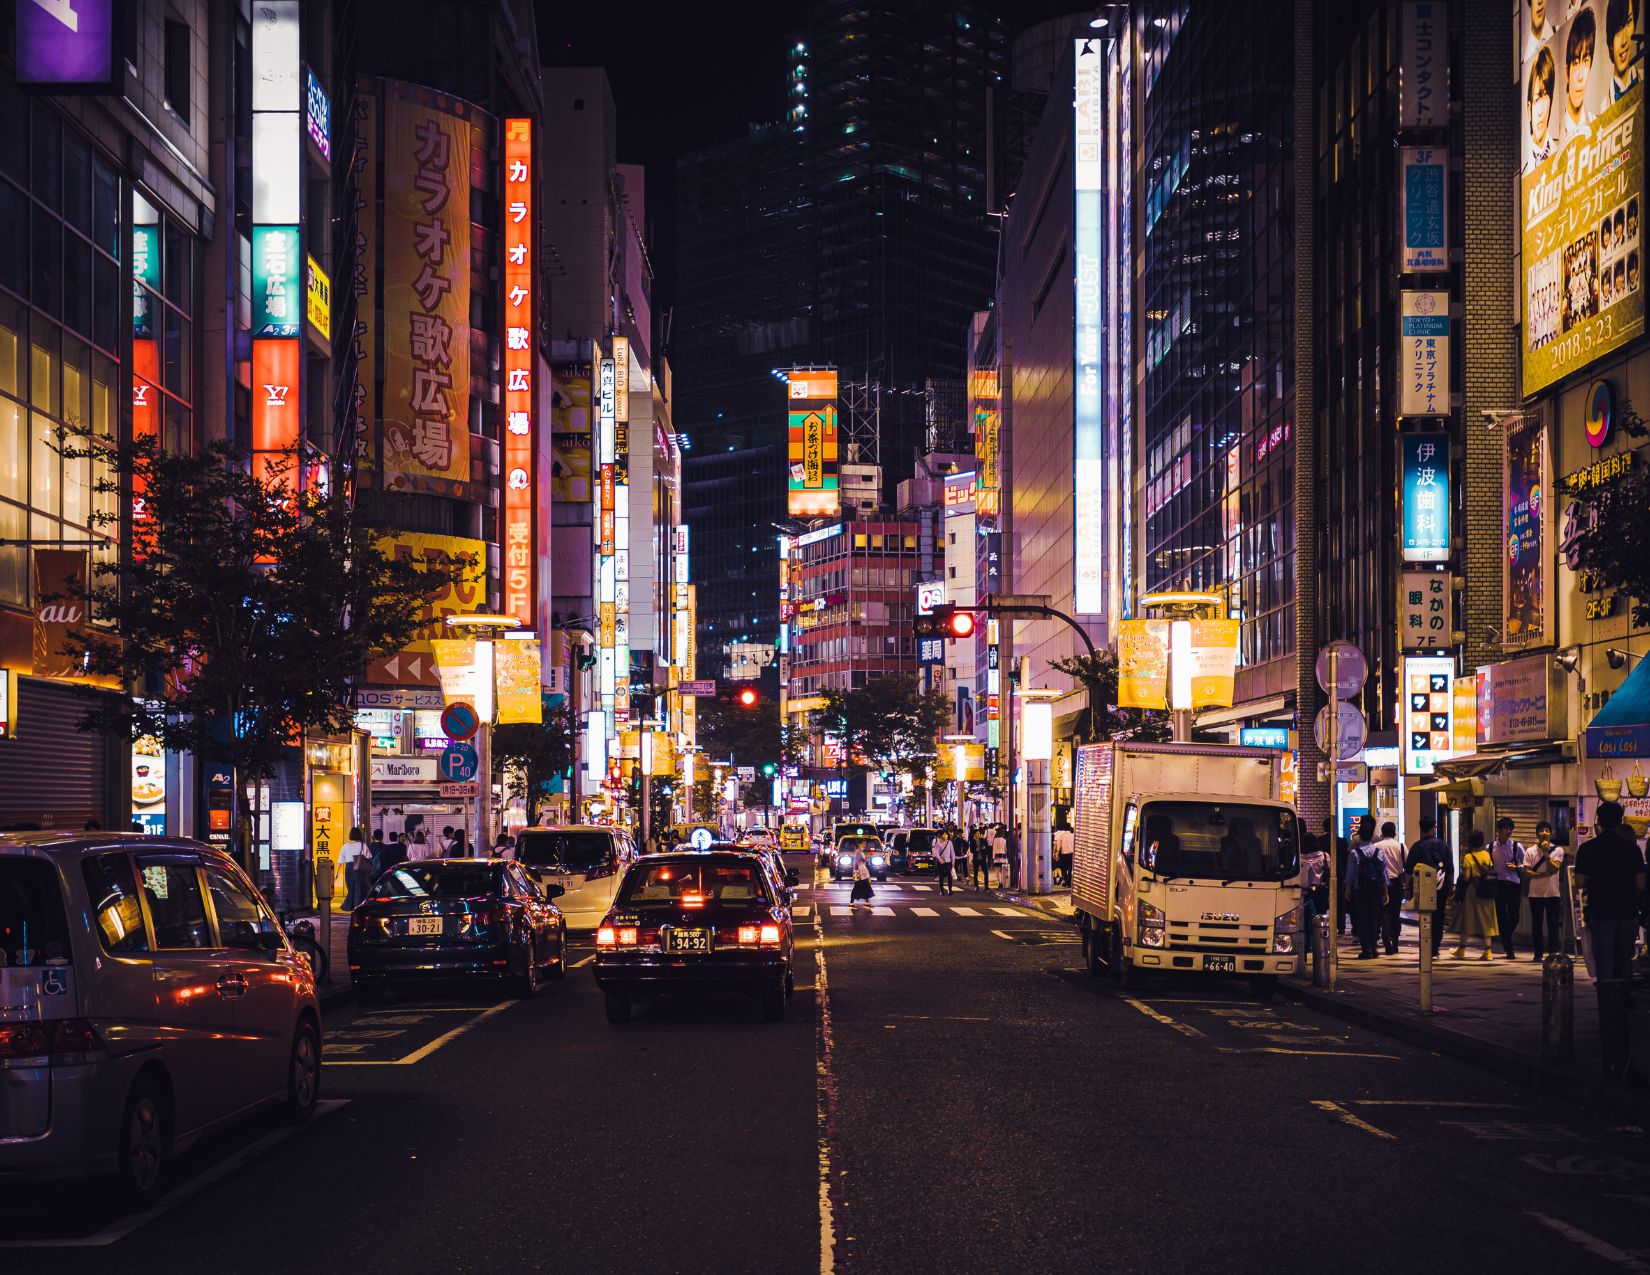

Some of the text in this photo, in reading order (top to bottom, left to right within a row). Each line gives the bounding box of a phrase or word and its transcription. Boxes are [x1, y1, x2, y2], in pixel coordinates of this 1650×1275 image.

[1416, 5, 1433, 115] 富士コンタクト
[1078, 68, 1091, 136] LABI
[1416, 150, 1433, 164] 3F
[1528, 117, 1633, 221] King & Prince
[1409, 167, 1424, 246] クリニック
[1425, 167, 1440, 246] 渋谷道玄坂
[1537, 170, 1629, 256] シンデレラガール
[410, 119, 452, 470] カラオケ歌広場
[508, 160, 529, 435] カラオケ歌広場
[280, 324, 296, 335] 3F
[1552, 315, 1612, 369] 2018.5.23
[562, 366, 591, 378] aiko
[1415, 338, 1424, 393] クリニック
[1425, 339, 1437, 413] 東京プラチナム
[562, 434, 591, 446] aiko
[1416, 443, 1436, 534] 伊波歯科
[39, 604, 83, 623] au
[1409, 590, 1423, 628] 眼科
[1430, 579, 1444, 631] なかの
[922, 640, 942, 660] 薬局
[1416, 637, 1436, 646] 7F
[395, 693, 445, 705] サービスス
[1243, 735, 1285, 746] 伊波歯科
[387, 764, 420, 776] Marlboro
[449, 753, 465, 777] P
[459, 767, 471, 778] 40
[1200, 912, 1240, 921] ISUZU
[416, 924, 440, 934] 30-21
[1209, 961, 1235, 972] 66-40
